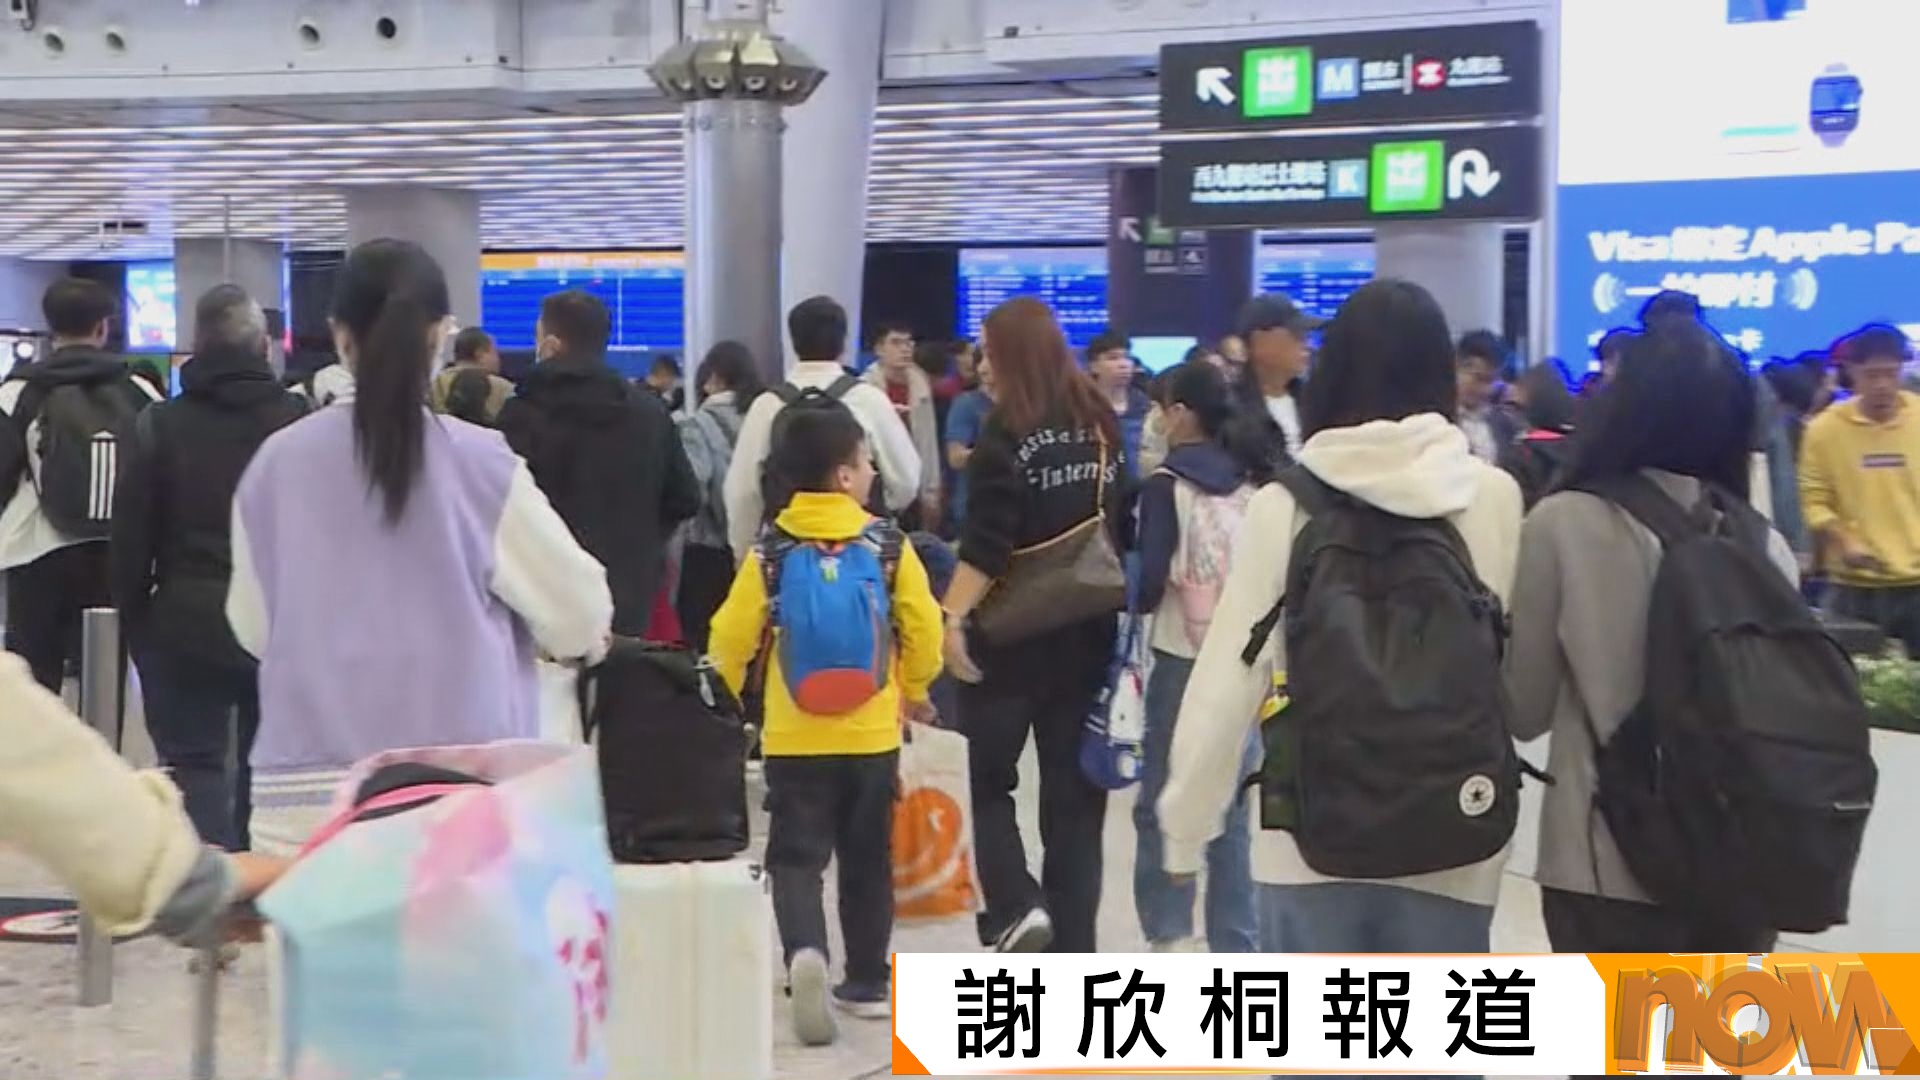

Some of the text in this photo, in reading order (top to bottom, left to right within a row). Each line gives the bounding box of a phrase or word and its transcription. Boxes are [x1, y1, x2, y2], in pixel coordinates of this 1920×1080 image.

[1322, 64, 1353, 92] M
[1337, 164, 1359, 193] K
[1749, 223, 1873, 263] Apple
[1875, 222, 1920, 254] Pa
